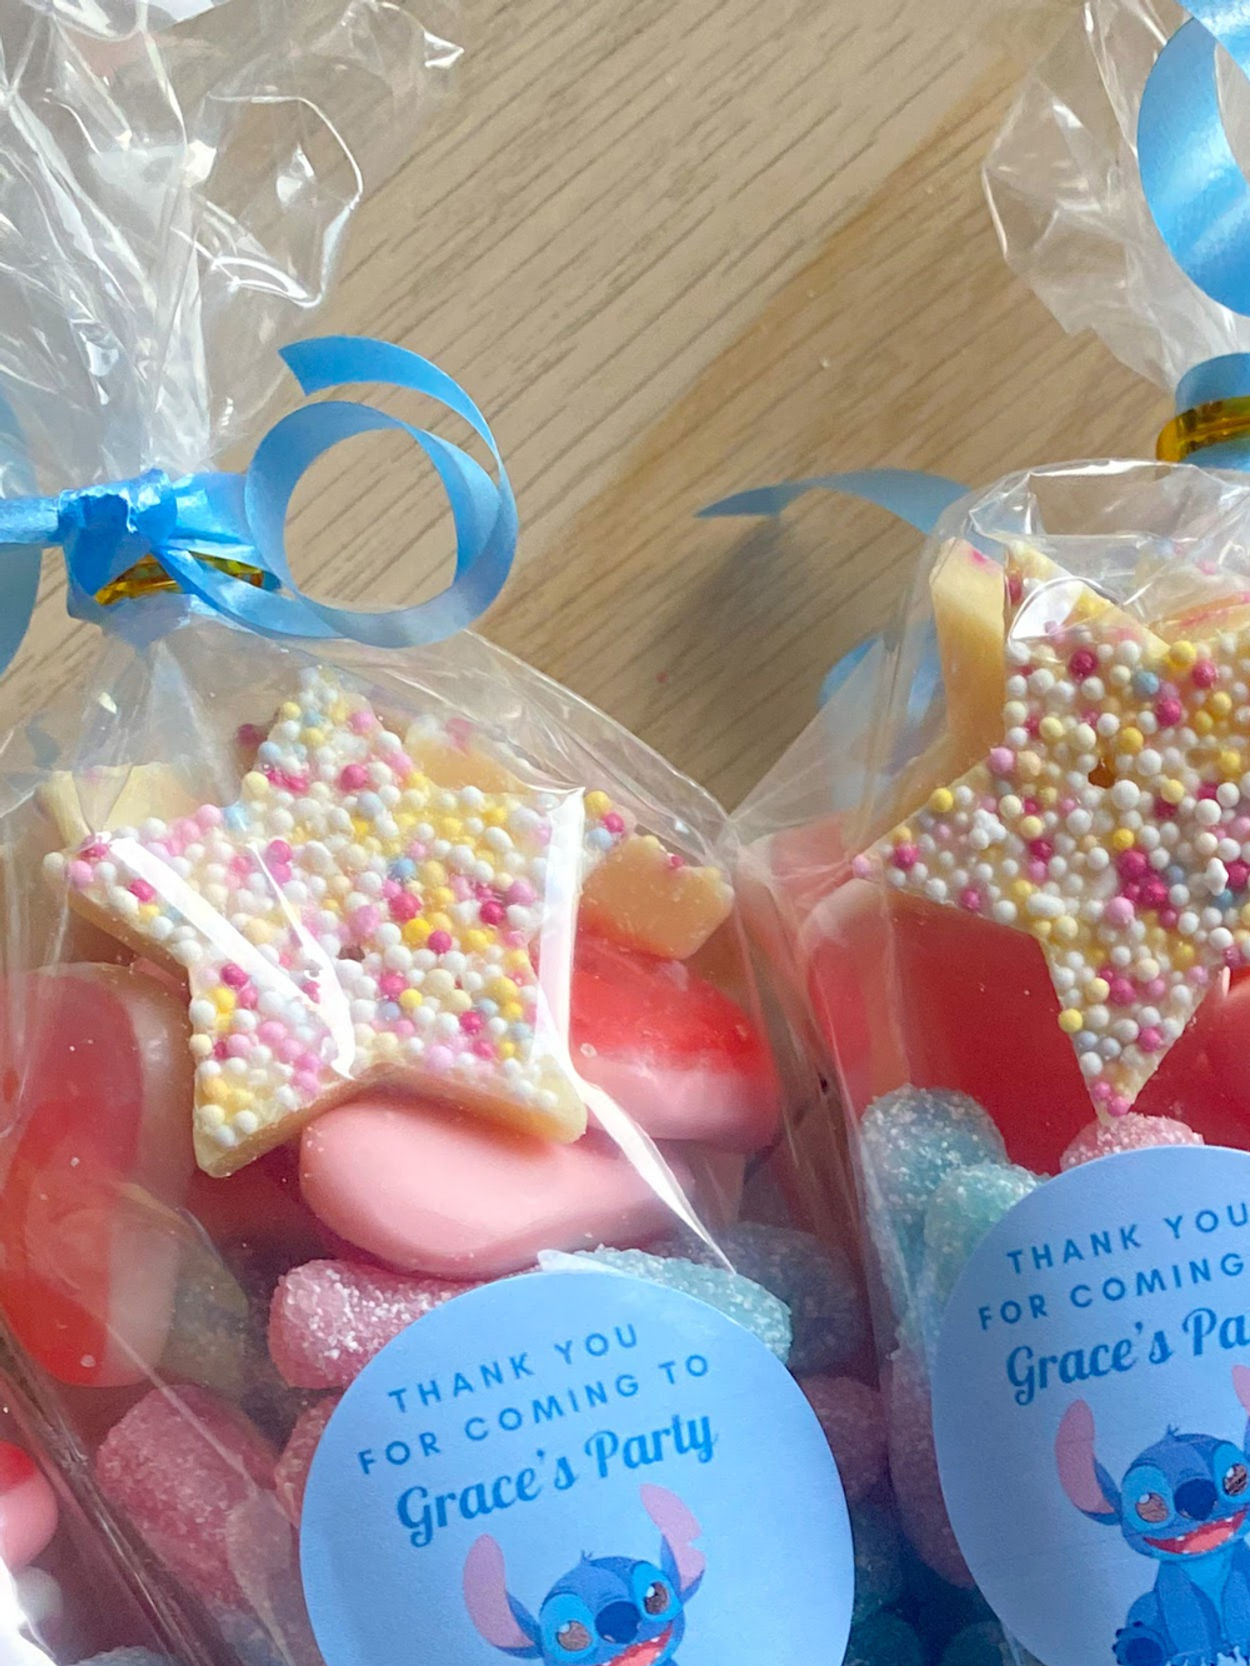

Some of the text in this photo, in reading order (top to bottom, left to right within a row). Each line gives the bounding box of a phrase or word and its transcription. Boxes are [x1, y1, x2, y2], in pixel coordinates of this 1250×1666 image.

[1007, 1203, 1249, 1275] THANK YOU
[978, 1294, 1047, 1331] FOR
[1070, 1253, 1245, 1308] COMING
[389, 1324, 638, 1413] THANK YOU
[1006, 1321, 1174, 1406] Grace's
[358, 1355, 709, 1474] FOR COMING TO
[396, 1412, 718, 1548] Grace's Party
